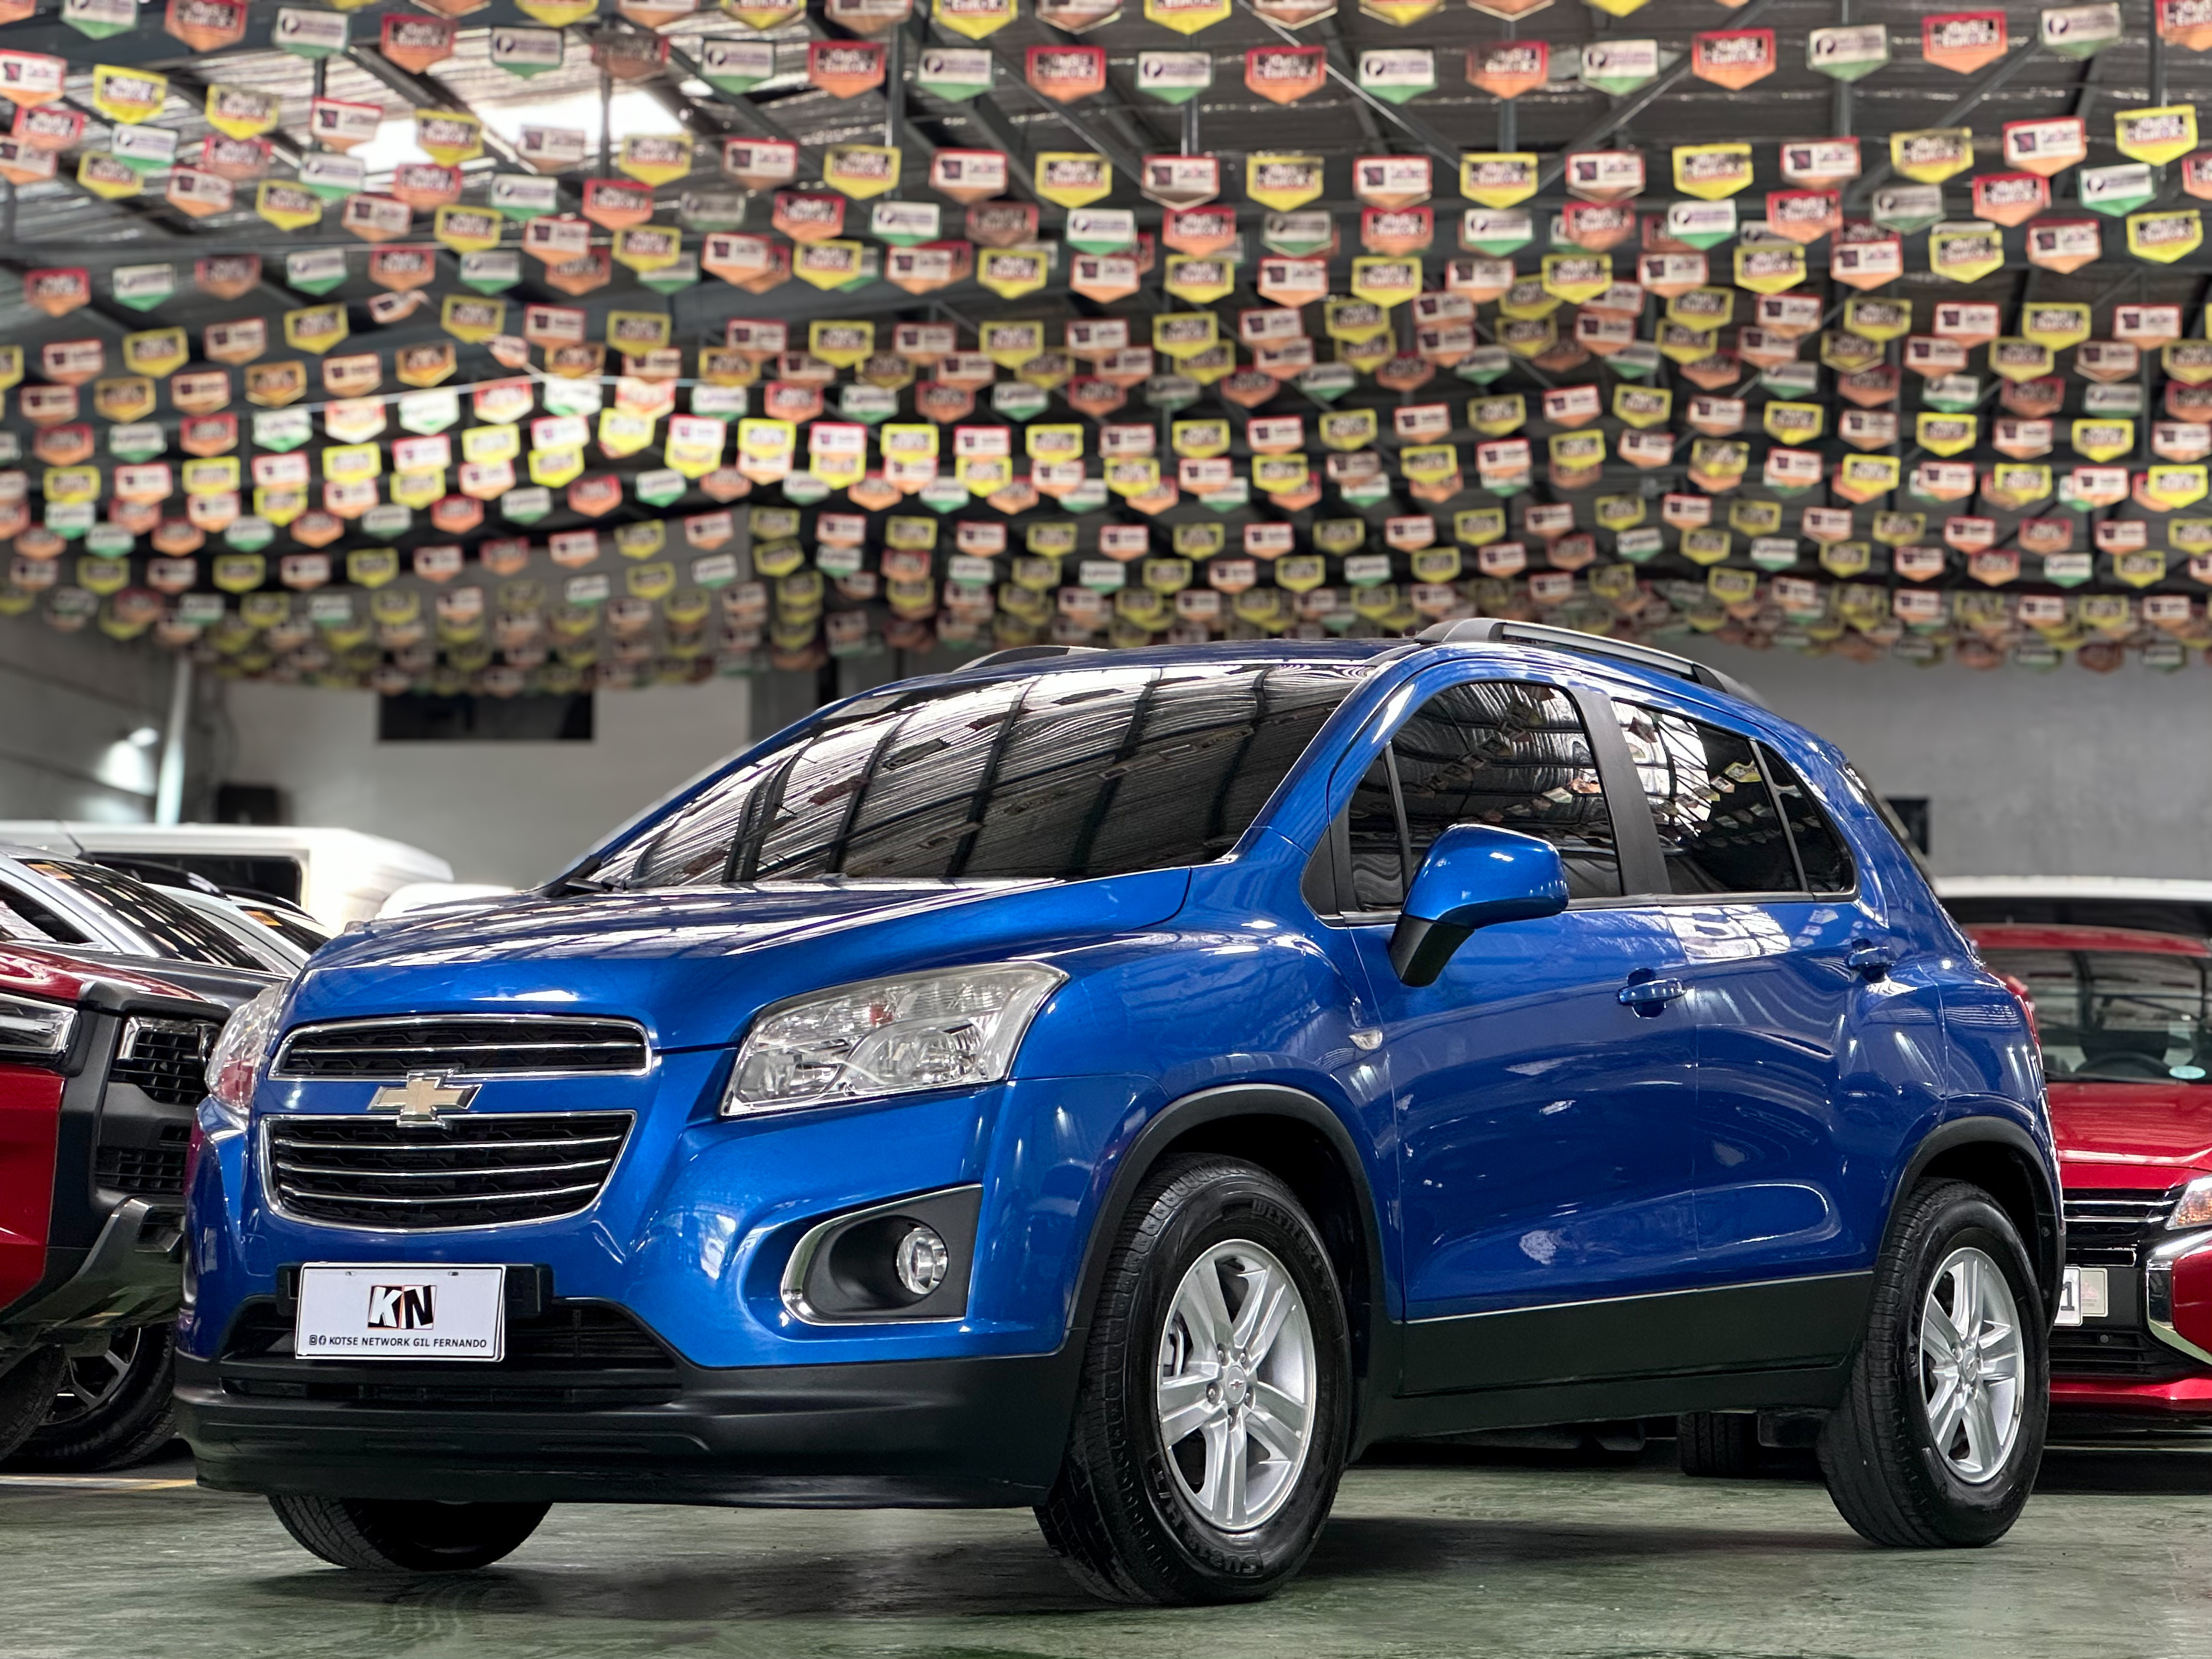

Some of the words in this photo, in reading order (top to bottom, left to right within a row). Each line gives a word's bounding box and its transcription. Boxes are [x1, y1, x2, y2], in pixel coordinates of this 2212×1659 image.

[369, 1285, 434, 1329] KN
[329, 1337, 359, 1345] KOTSE
[362, 1337, 410, 1347] NETWORK
[413, 1338, 430, 1347] GIL
[434, 1339, 487, 1348] FERNANDO
